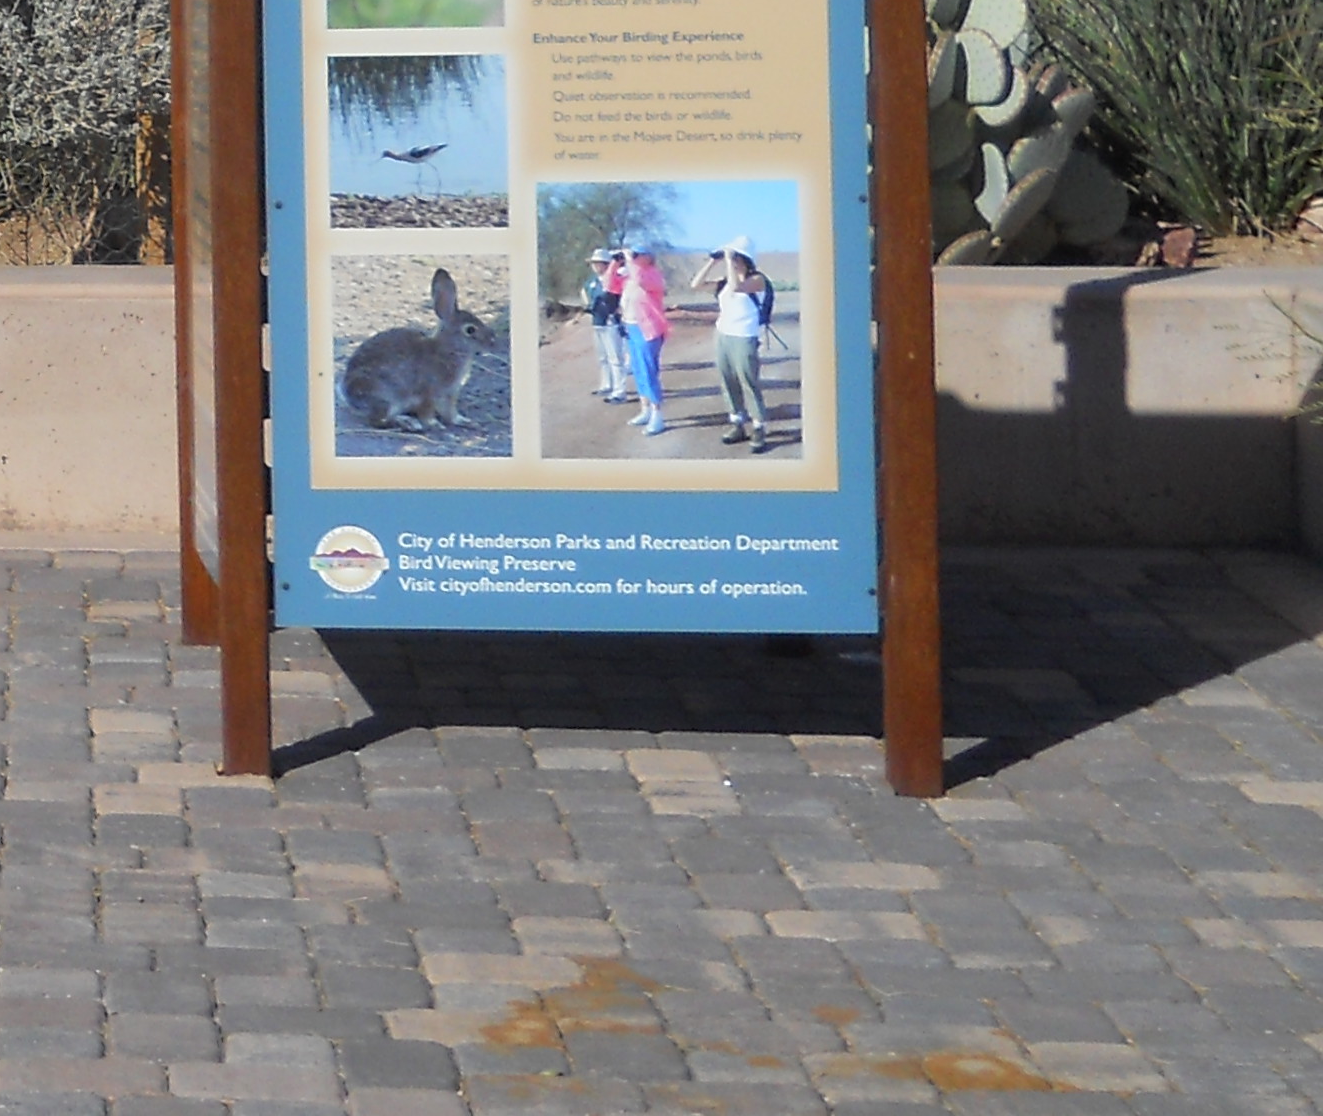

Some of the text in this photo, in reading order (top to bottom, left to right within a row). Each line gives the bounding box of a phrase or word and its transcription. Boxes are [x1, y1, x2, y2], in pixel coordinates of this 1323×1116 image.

[532, 30, 744, 45] Enhance Your Birding Experience
[551, 52, 574, 64] Use
[576, 53, 627, 66] pathways
[631, 54, 643, 62] to
[647, 54, 673, 62] view
[675, 52, 693, 62] the
[735, 50, 763, 61] birds
[552, 71, 573, 82] and
[552, 90, 585, 103] Quiet
[588, 92, 654, 101] observation
[553, 111, 571, 123] Do
[575, 114, 594, 122] not
[597, 111, 621, 122] feed
[624, 111, 642, 122] the
[645, 111, 673, 121] birds
[554, 132, 575, 143] You
[577, 134, 595, 143] are
[611, 133, 631, 143] the
[633, 131, 673, 144] Mojave
[720, 133, 733, 141] so
[736, 130, 765, 140] drink
[768, 130, 803, 143] plenty
[554, 149, 566, 160] of
[398, 533, 839, 555] City of Henderson Parks and Recreation Department
[399, 556, 432, 571] Bird
[435, 556, 499, 575] Viewing
[504, 556, 577, 572] Preserve
[398, 576, 807, 599] Visit cityofhenderson.com for hours of operation.
